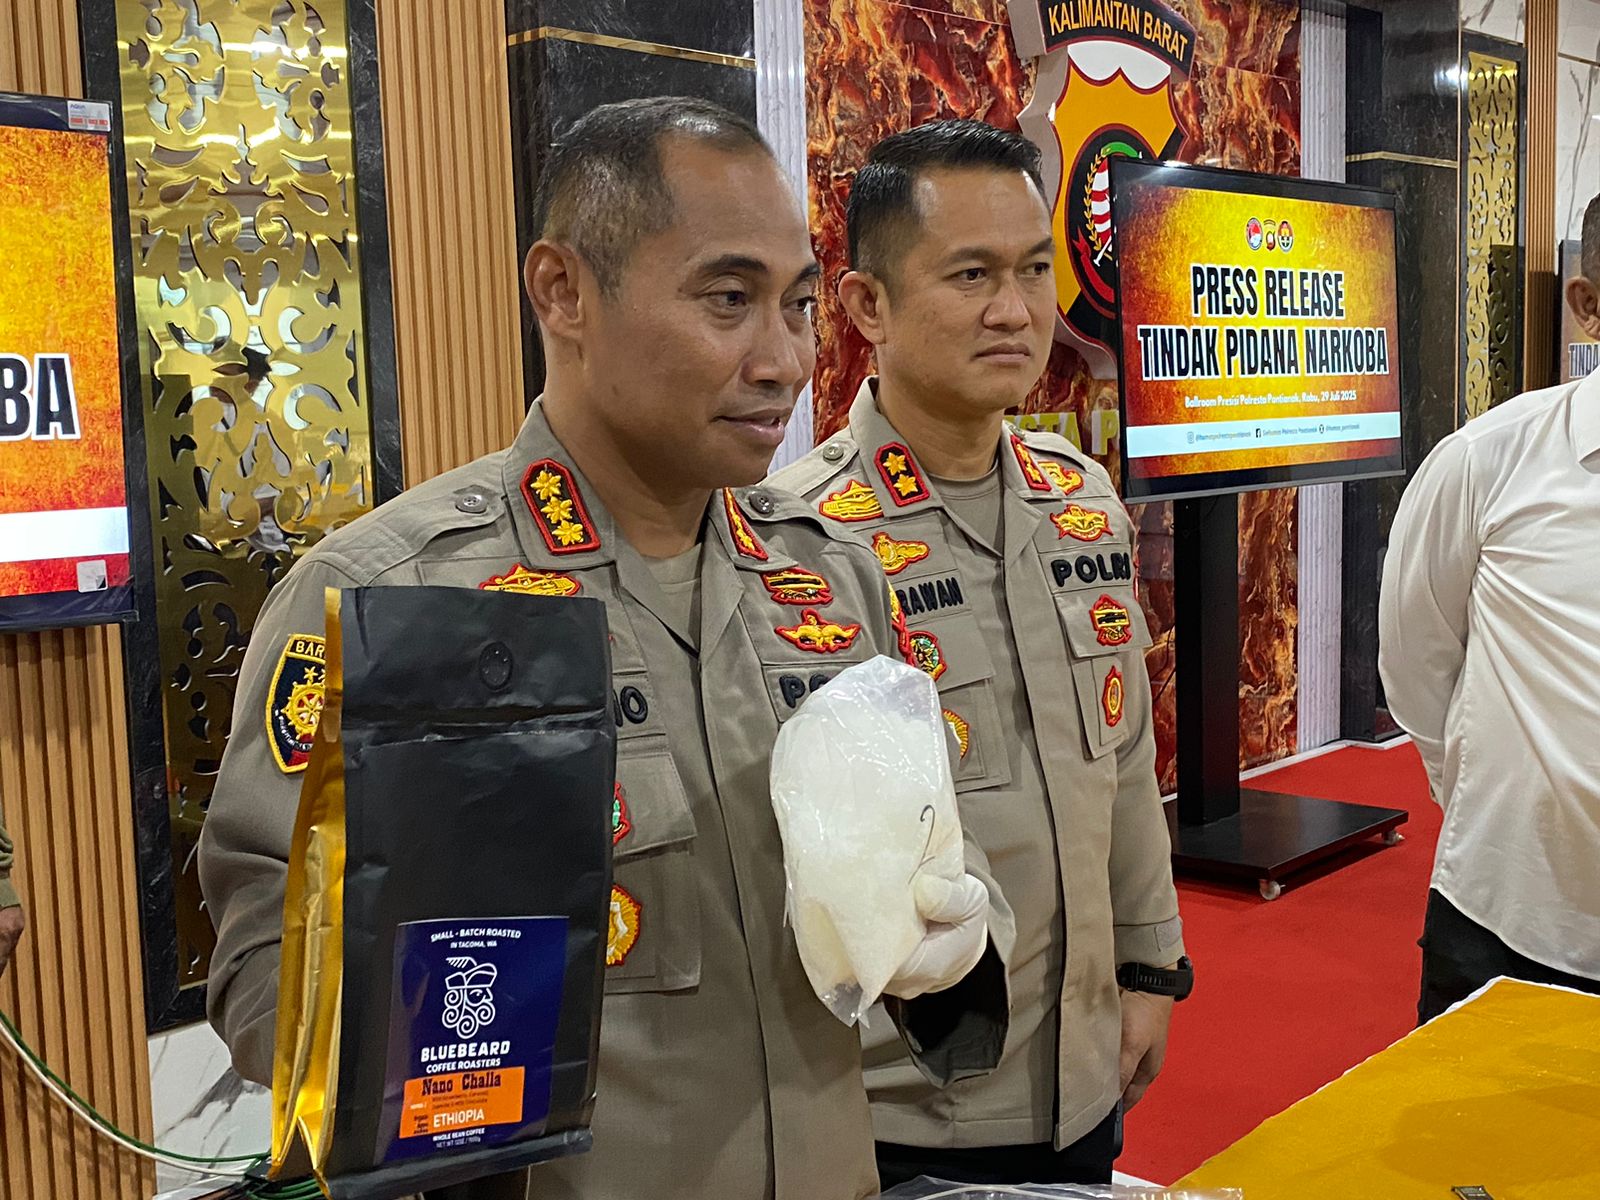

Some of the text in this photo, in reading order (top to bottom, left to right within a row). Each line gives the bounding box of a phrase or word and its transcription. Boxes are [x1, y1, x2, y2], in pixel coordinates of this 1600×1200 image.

[1048, 0, 1188, 62] KALIMANTAN BARAT
[1191, 263, 1345, 319] PRESS RELEASE
[1137, 325, 1389, 380] TINDAK PIDANA NARKOBA
[1321, 391, 1330, 401] 29
[1341, 390, 1357, 401] 2025
[1051, 552, 1131, 587] POLRI
[431, 930, 454, 942] SMALL
[459, 928, 486, 937] BATCH
[486, 928, 521, 939] ROASTED
[421, 1040, 510, 1062] BLUEBEARD
[426, 1058, 501, 1074] COFFEE ROASTERS
[422, 1078, 453, 1096] Nano
[462, 1071, 501, 1090] Challa
[433, 1108, 485, 1128] ETHIOPIA
[465, 1128, 485, 1137] COFFEE
